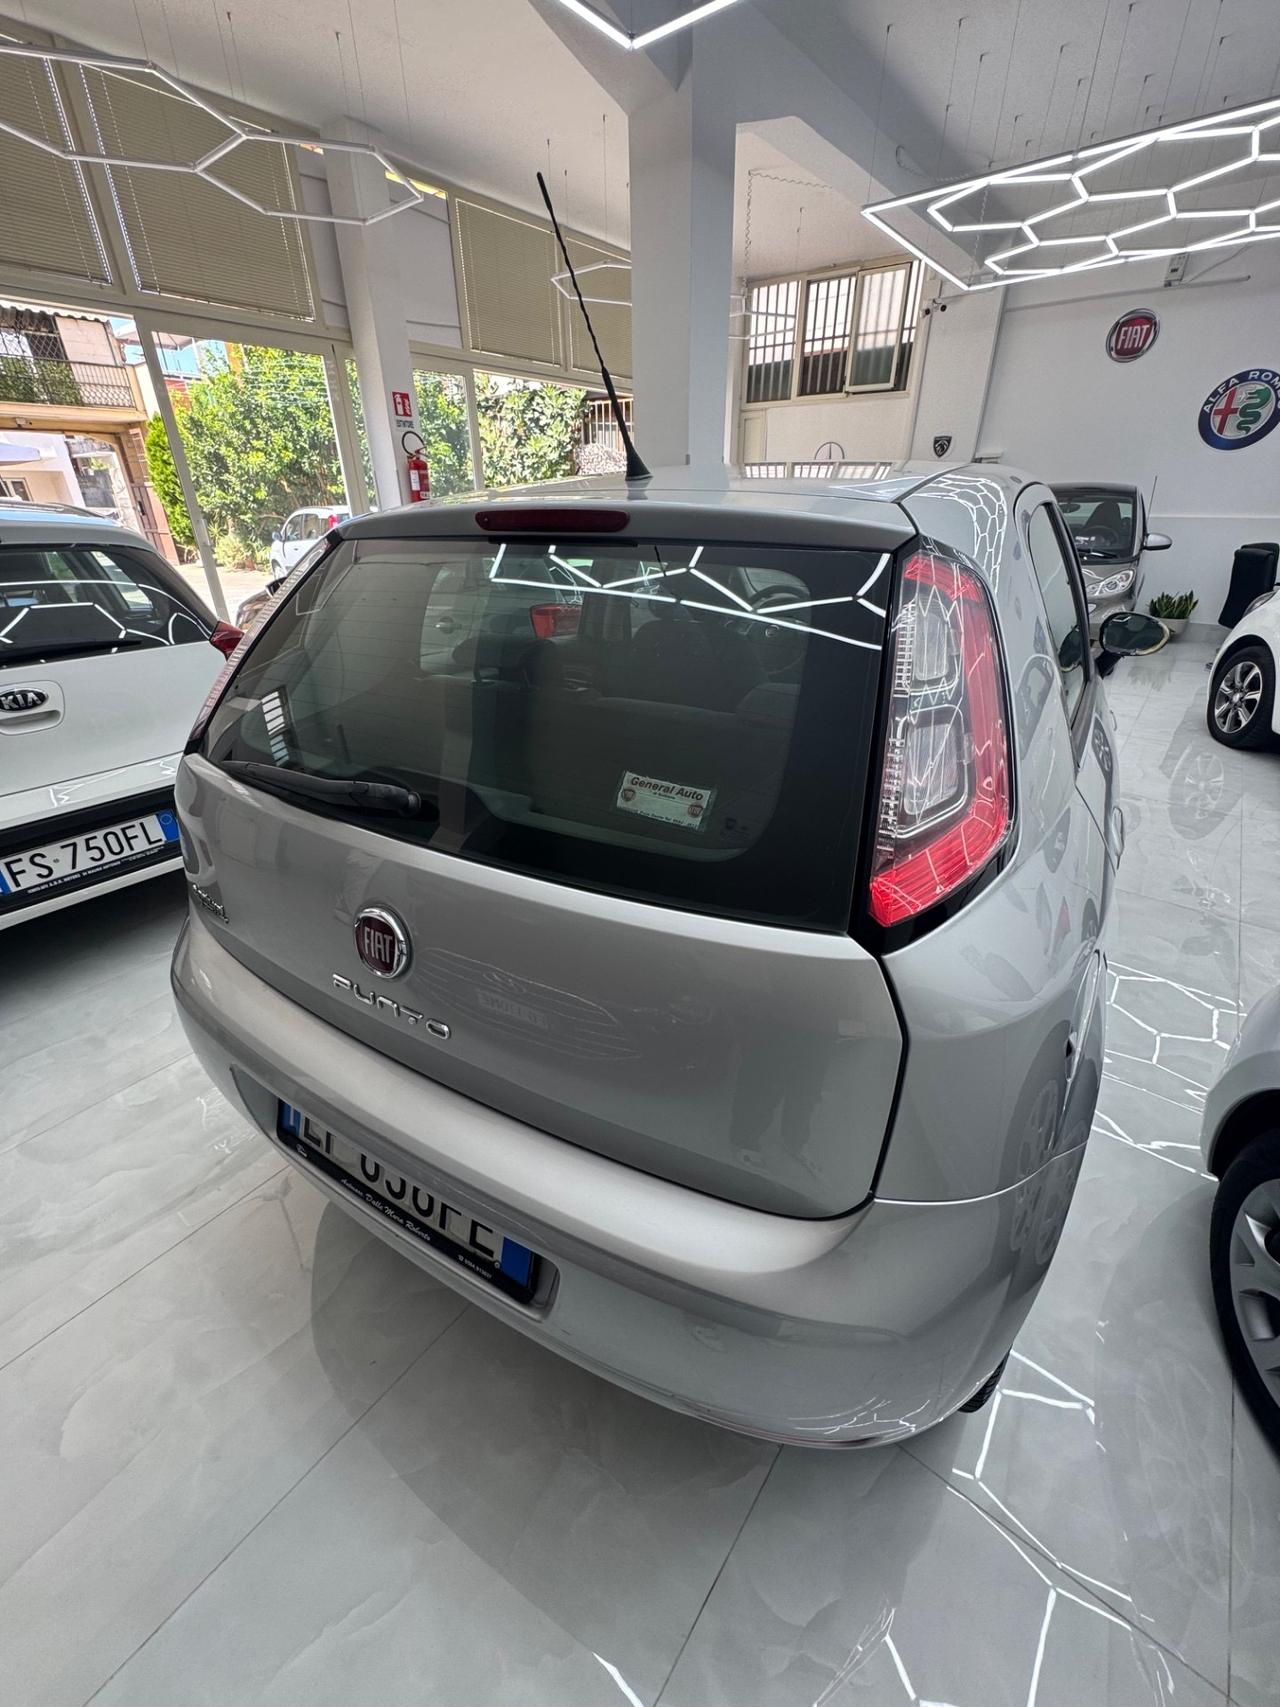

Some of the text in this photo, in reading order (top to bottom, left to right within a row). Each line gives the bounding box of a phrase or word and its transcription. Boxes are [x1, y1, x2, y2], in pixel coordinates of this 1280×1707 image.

[1117, 324, 1150, 350] FIAT
[1203, 377, 1240, 414] ALFA
[1, 692, 42, 709] KIA
[631, 776, 676, 794] General
[675, 788, 704, 801] Auto
[4, 821, 164, 888] FS 750FL
[364, 926, 393, 963] FIAT
[332, 973, 451, 1040] PUNTO
